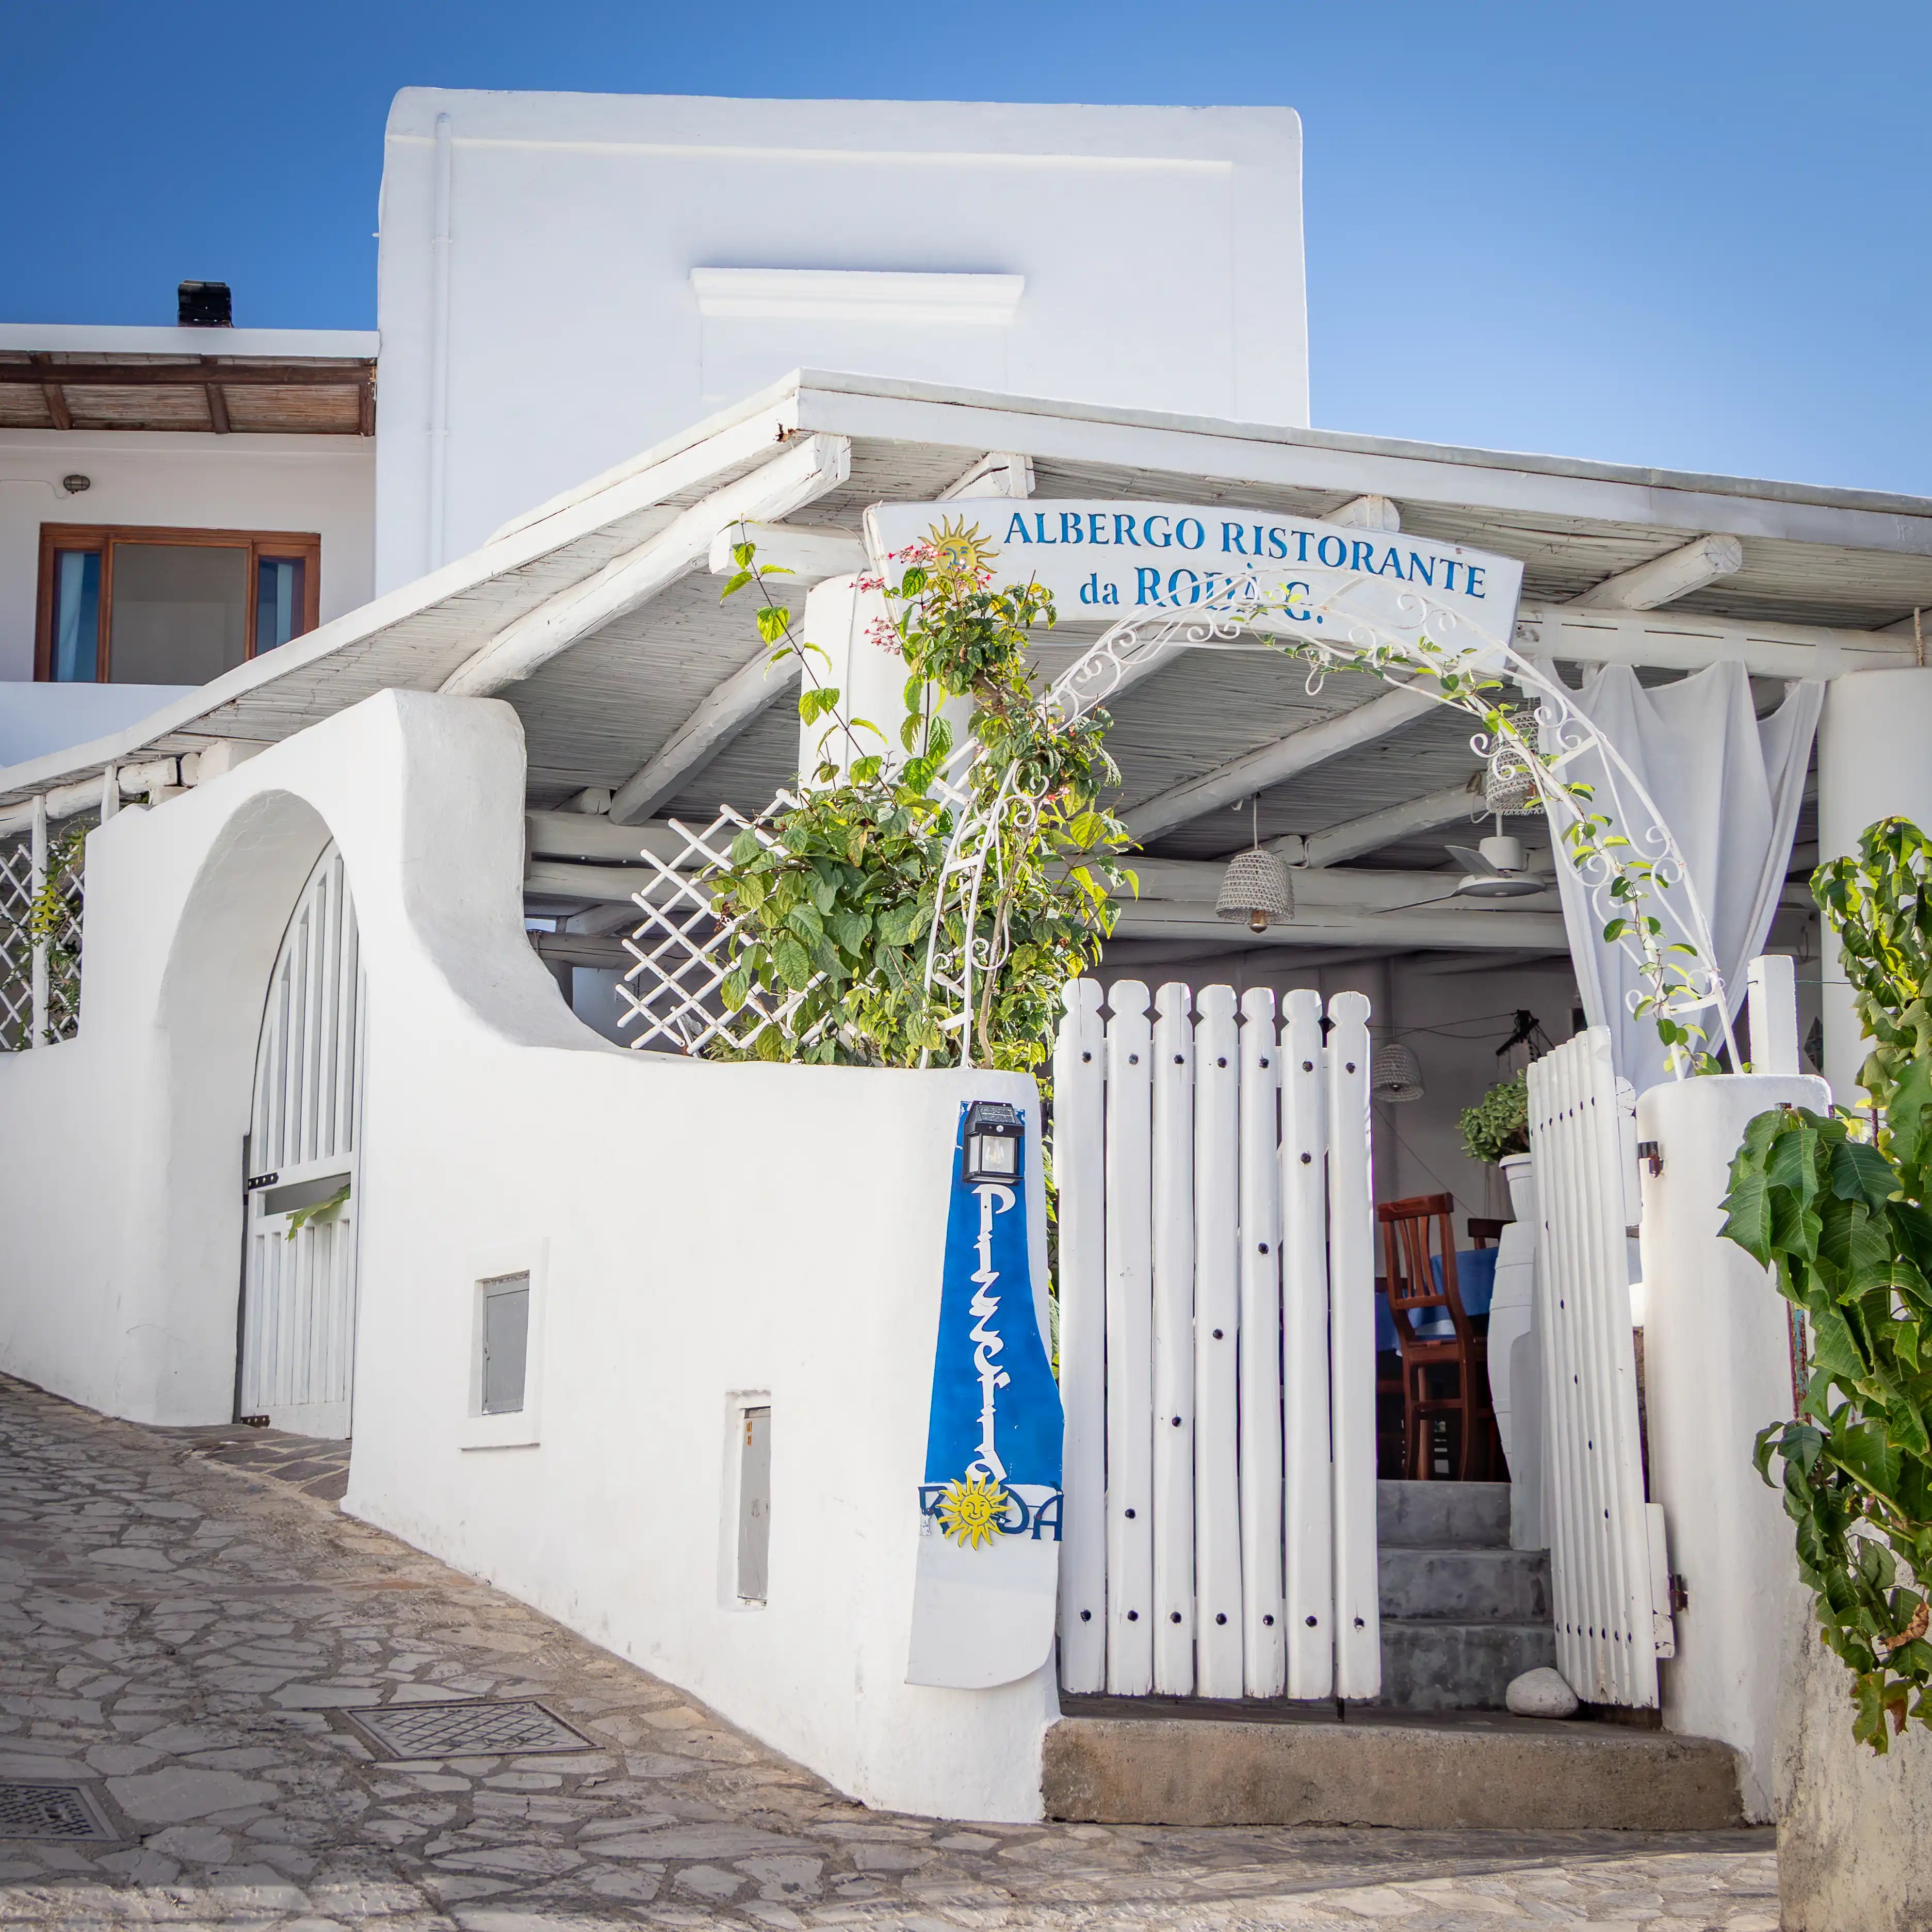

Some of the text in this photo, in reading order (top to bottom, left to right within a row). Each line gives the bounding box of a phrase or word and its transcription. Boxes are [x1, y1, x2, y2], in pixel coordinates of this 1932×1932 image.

[1004, 512, 1485, 598] ALBERGO RISTORANTE
[1079, 572, 1119, 605] da
[966, 1183, 1015, 1483] Pizzeria
